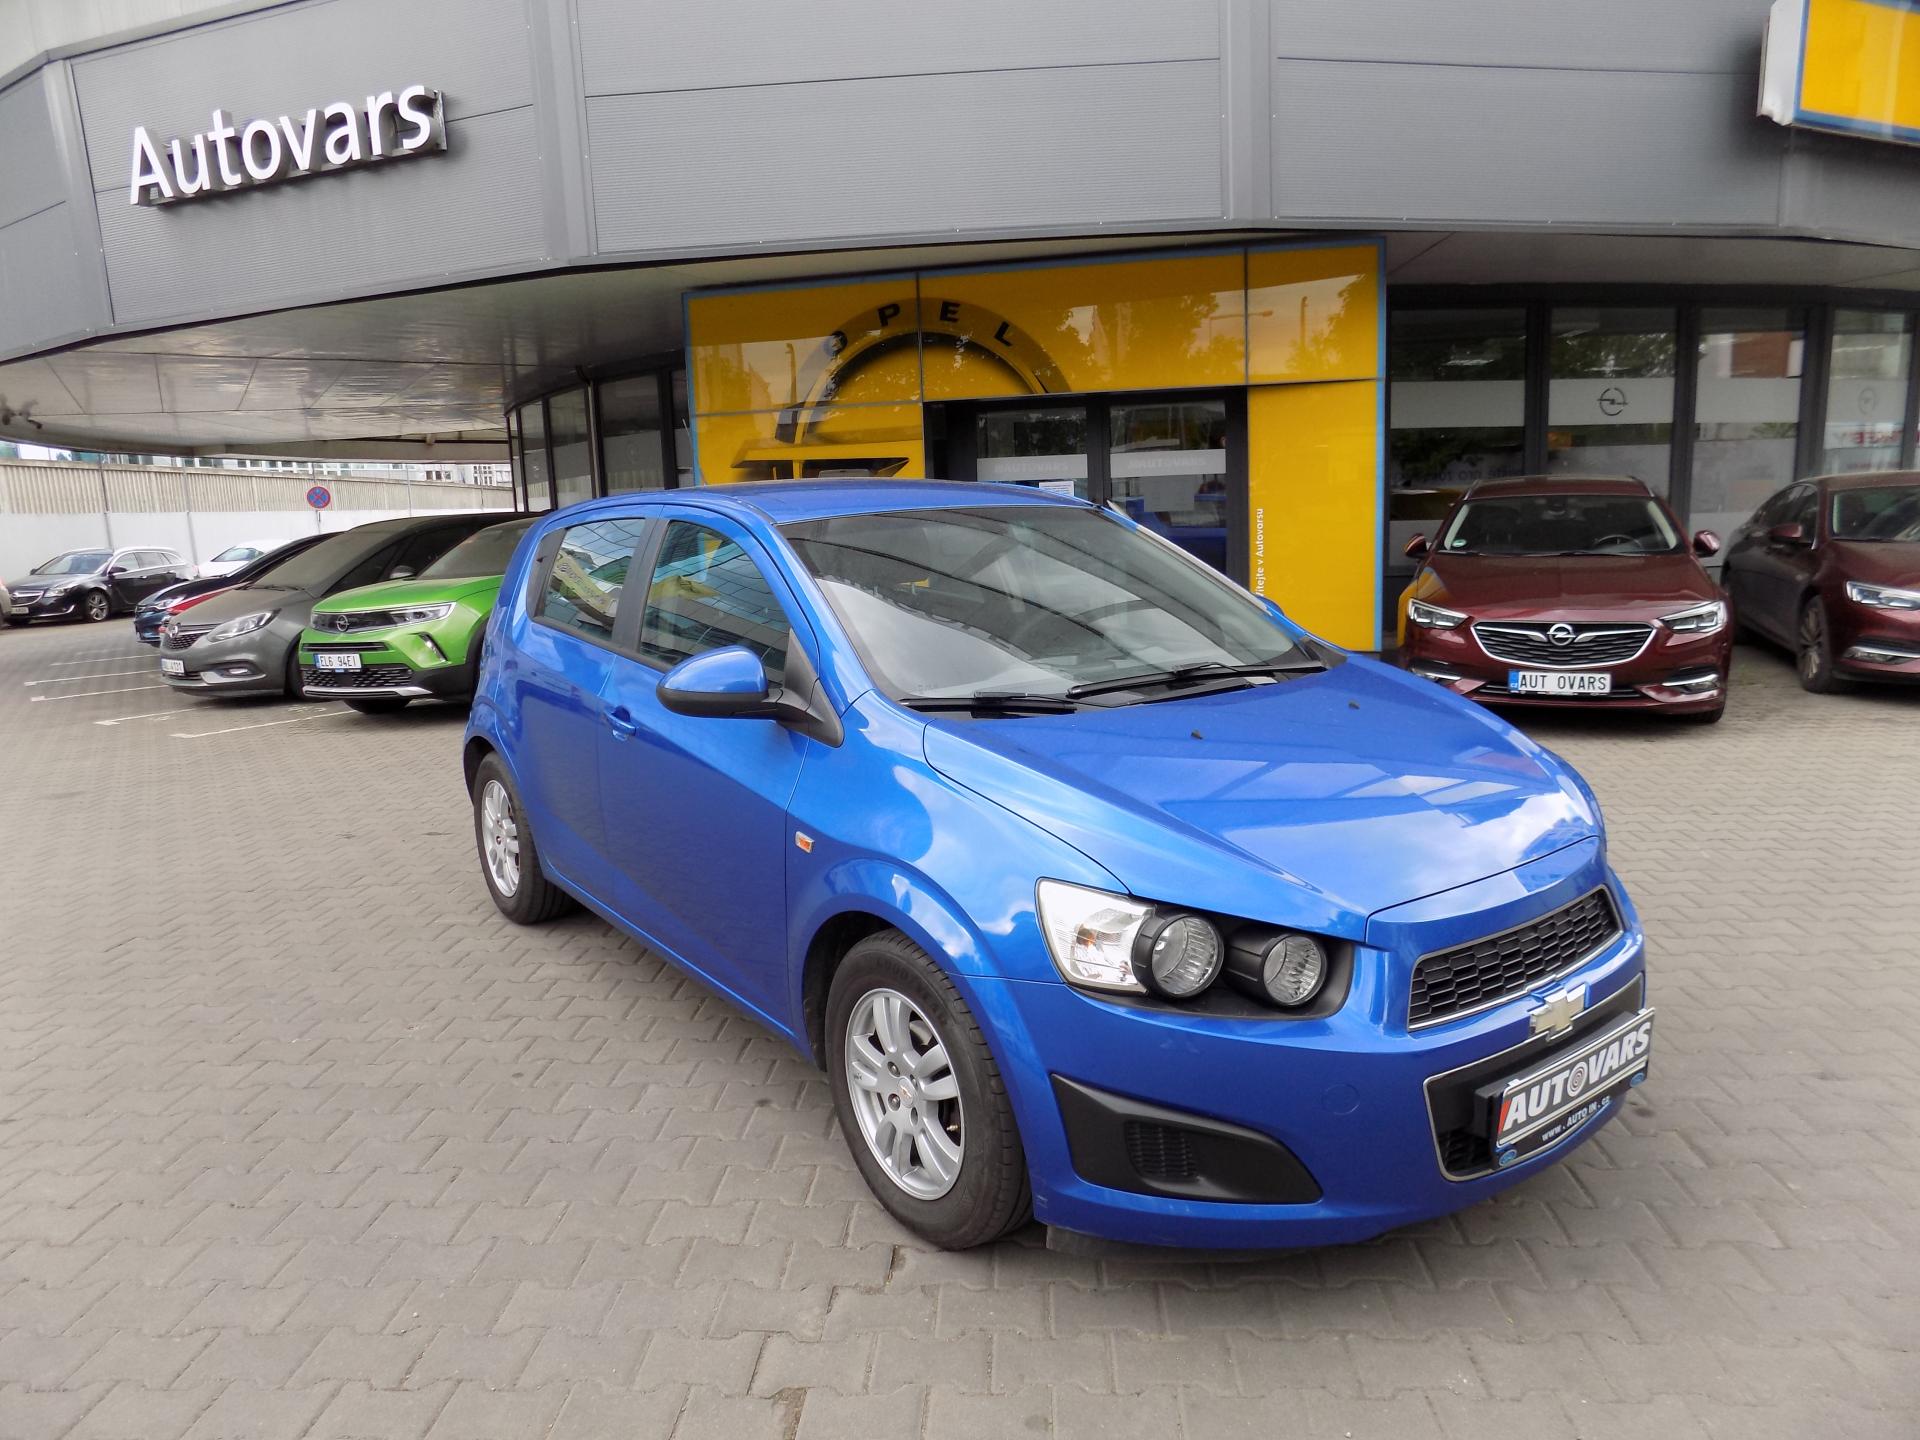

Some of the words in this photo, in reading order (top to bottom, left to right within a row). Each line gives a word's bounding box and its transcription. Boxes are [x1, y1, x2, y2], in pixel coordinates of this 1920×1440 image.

[130, 85, 434, 205] Autovars
[1519, 674, 1548, 689] AUT
[1557, 675, 1607, 691] OVARS
[1502, 1021, 1651, 1131] AUTOVARS
